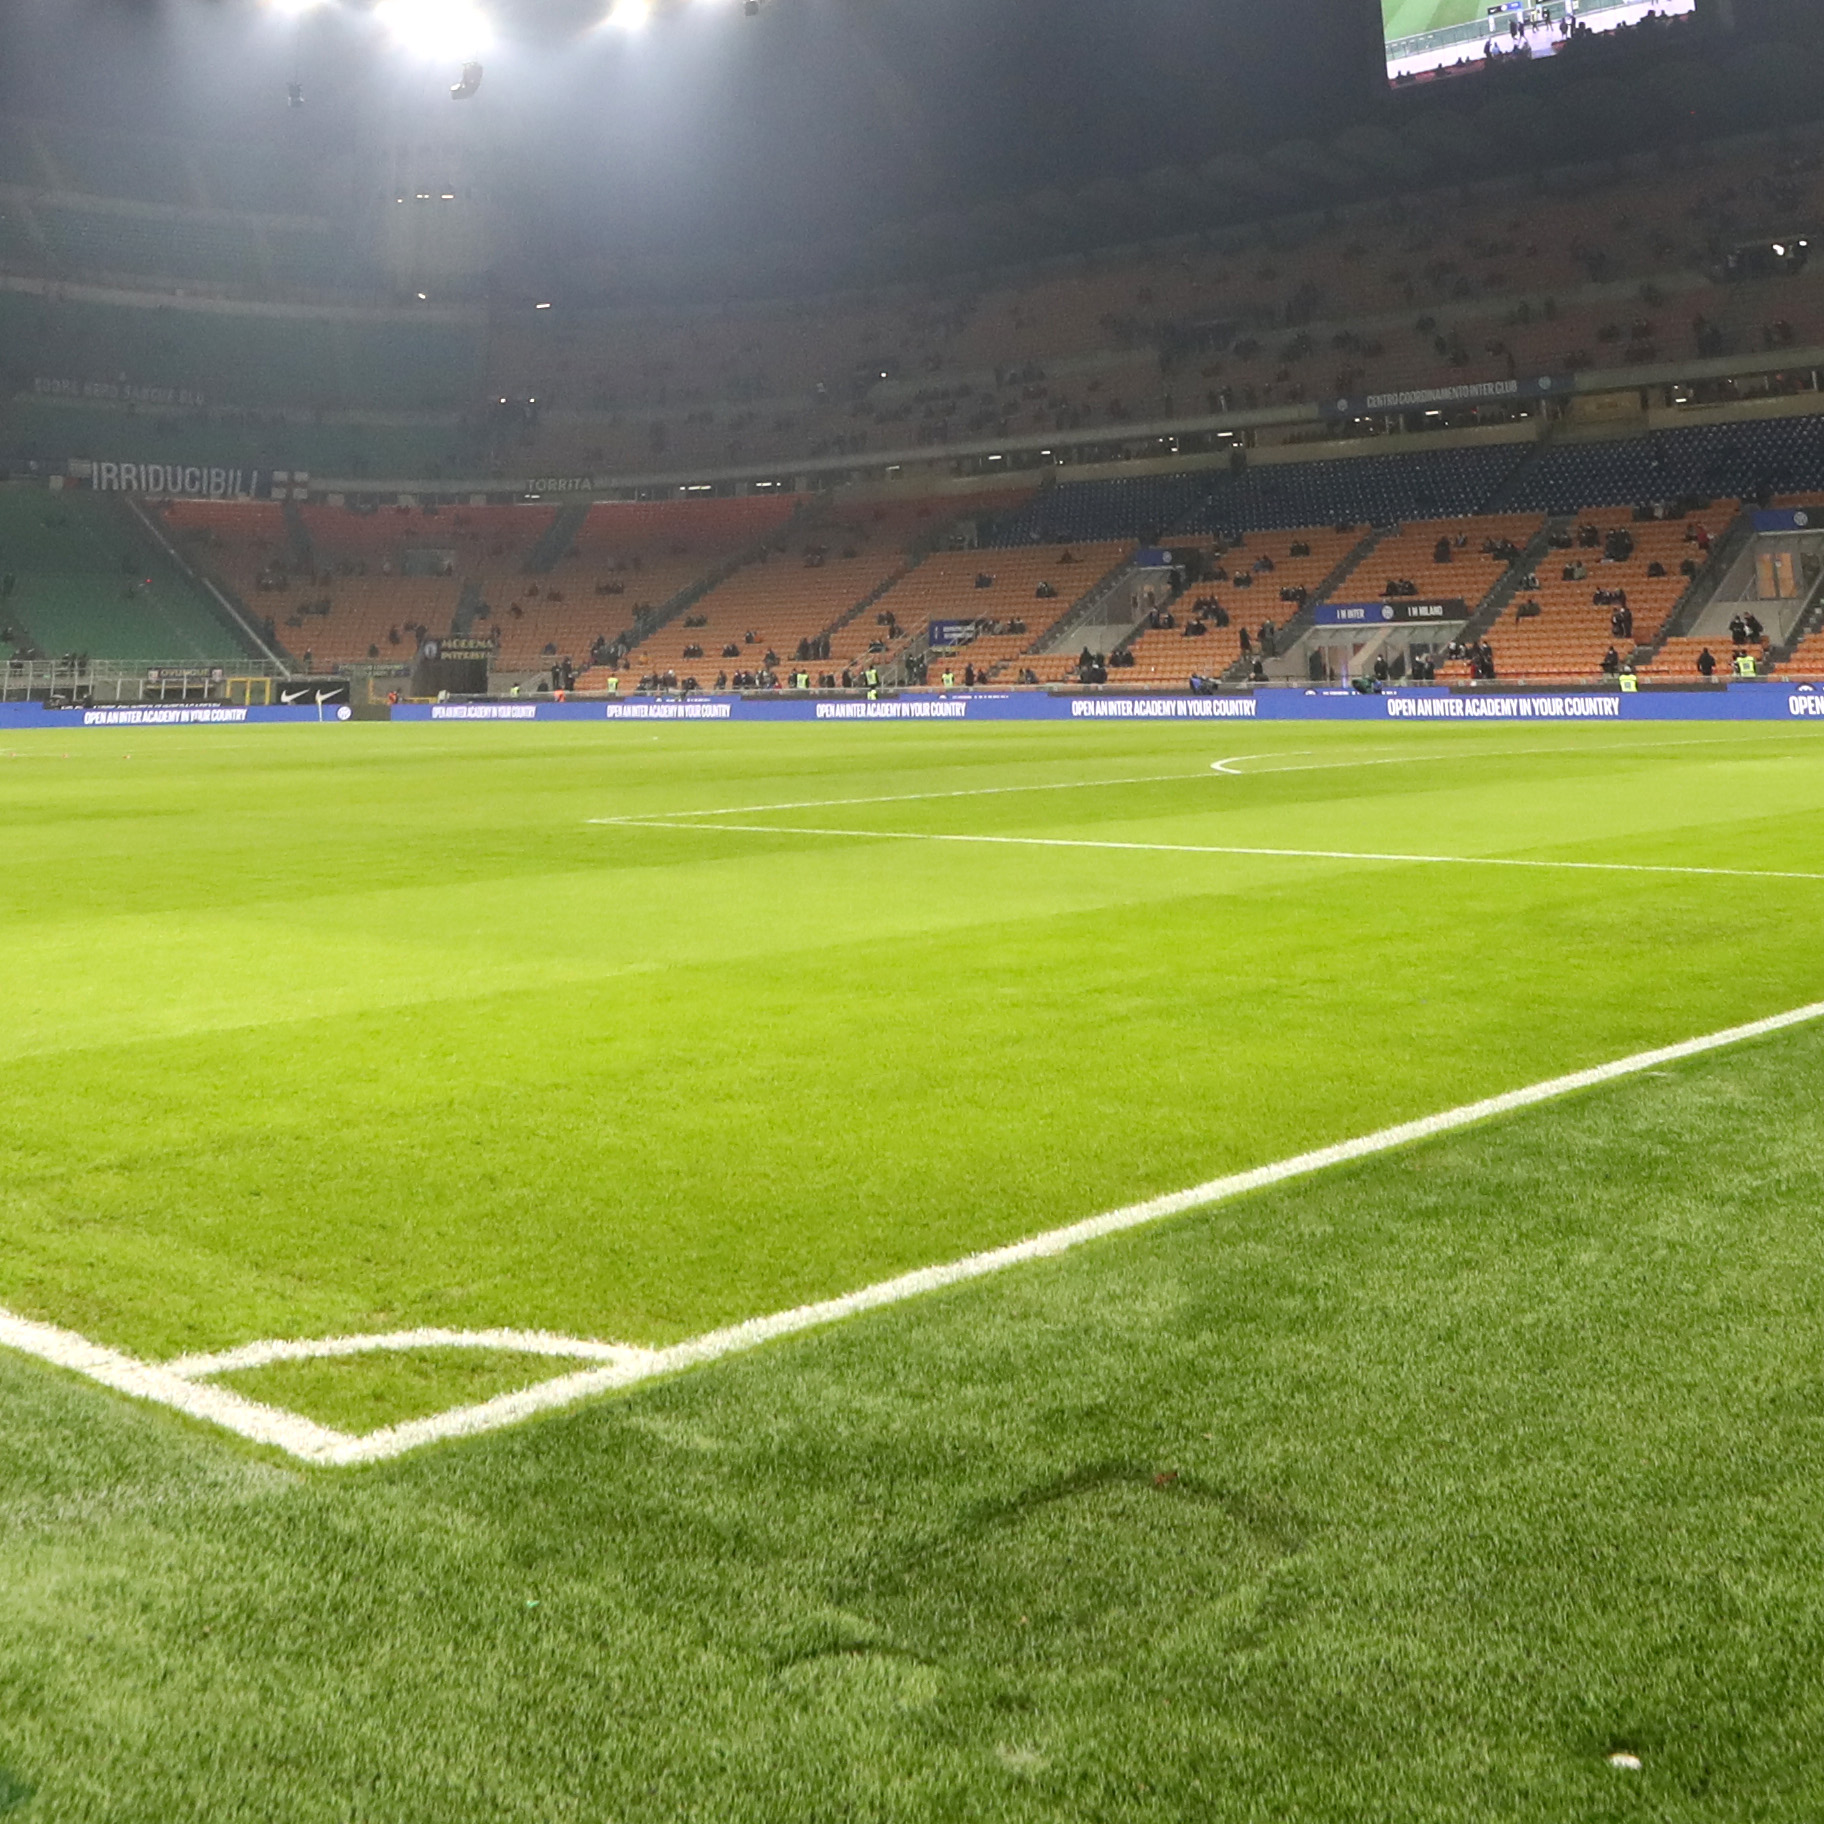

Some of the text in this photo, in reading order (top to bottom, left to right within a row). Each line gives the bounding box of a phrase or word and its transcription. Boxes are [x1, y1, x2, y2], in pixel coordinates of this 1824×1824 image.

[92, 461, 259, 497] IRRIDUCIBILI
[816, 702, 966, 718] OPEN AN INTER ACADEMY IN YOUR COUNTRY
[1071, 700, 1256, 716] OPEN AN INTER ACADEMY IN YOUR COUNTRY
[1387, 697, 1620, 716] OPEN AN INTER ACADEMY IN YOUR COUNTRY
[84, 711, 107, 725] OPEN
[106, 711, 119, 724] AN
[118, 710, 142, 724] INTER
[142, 709, 181, 723] ACADEMY
[180, 710, 190, 722] IN
[211, 708, 248, 721] COUNTRY
